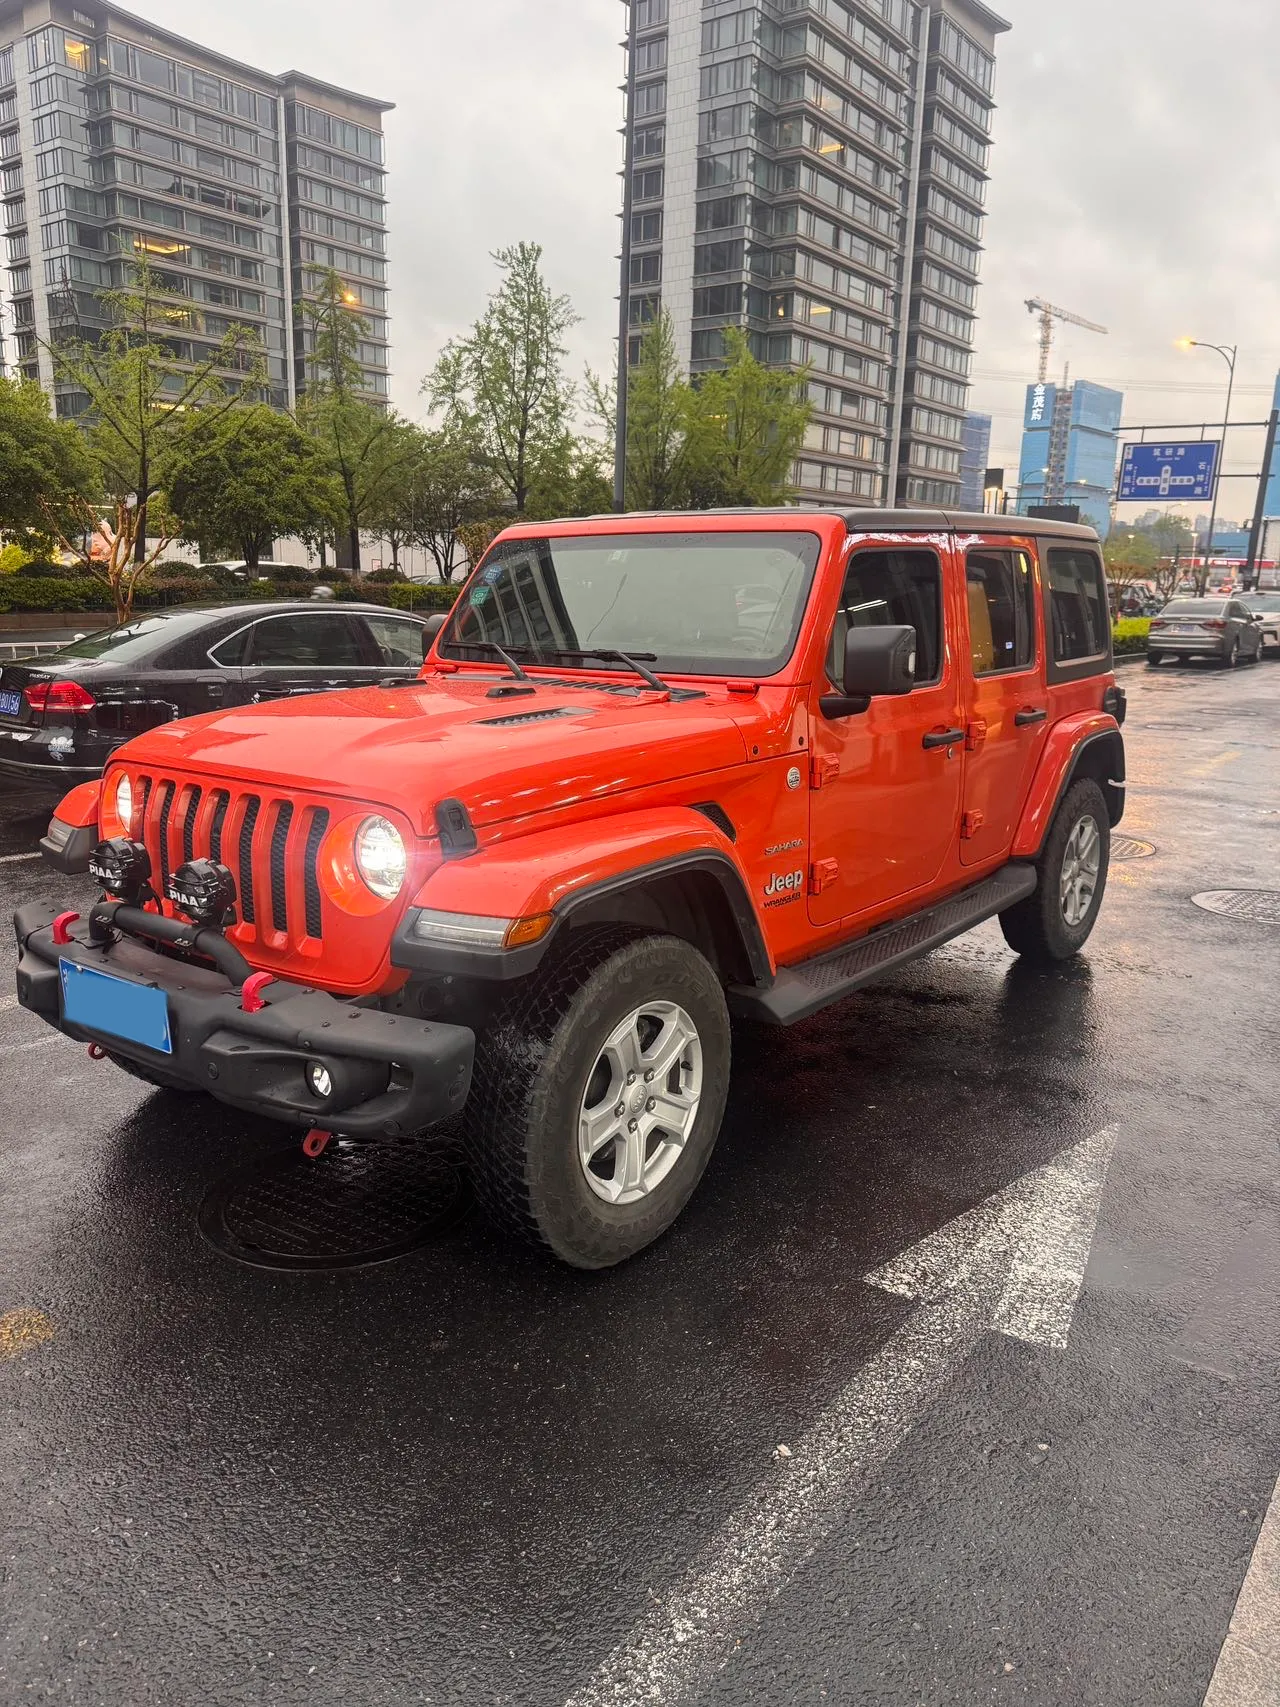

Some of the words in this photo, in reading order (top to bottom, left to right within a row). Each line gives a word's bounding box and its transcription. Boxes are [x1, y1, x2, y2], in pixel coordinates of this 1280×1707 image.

[1031, 383, 1046, 421] 金茂府
[764, 838, 804, 856] SAHARA
[89, 863, 113, 879] PIAA
[764, 869, 804, 895] Jeep
[169, 889, 199, 907] PIAA
[763, 892, 801, 908] WRANGLER
